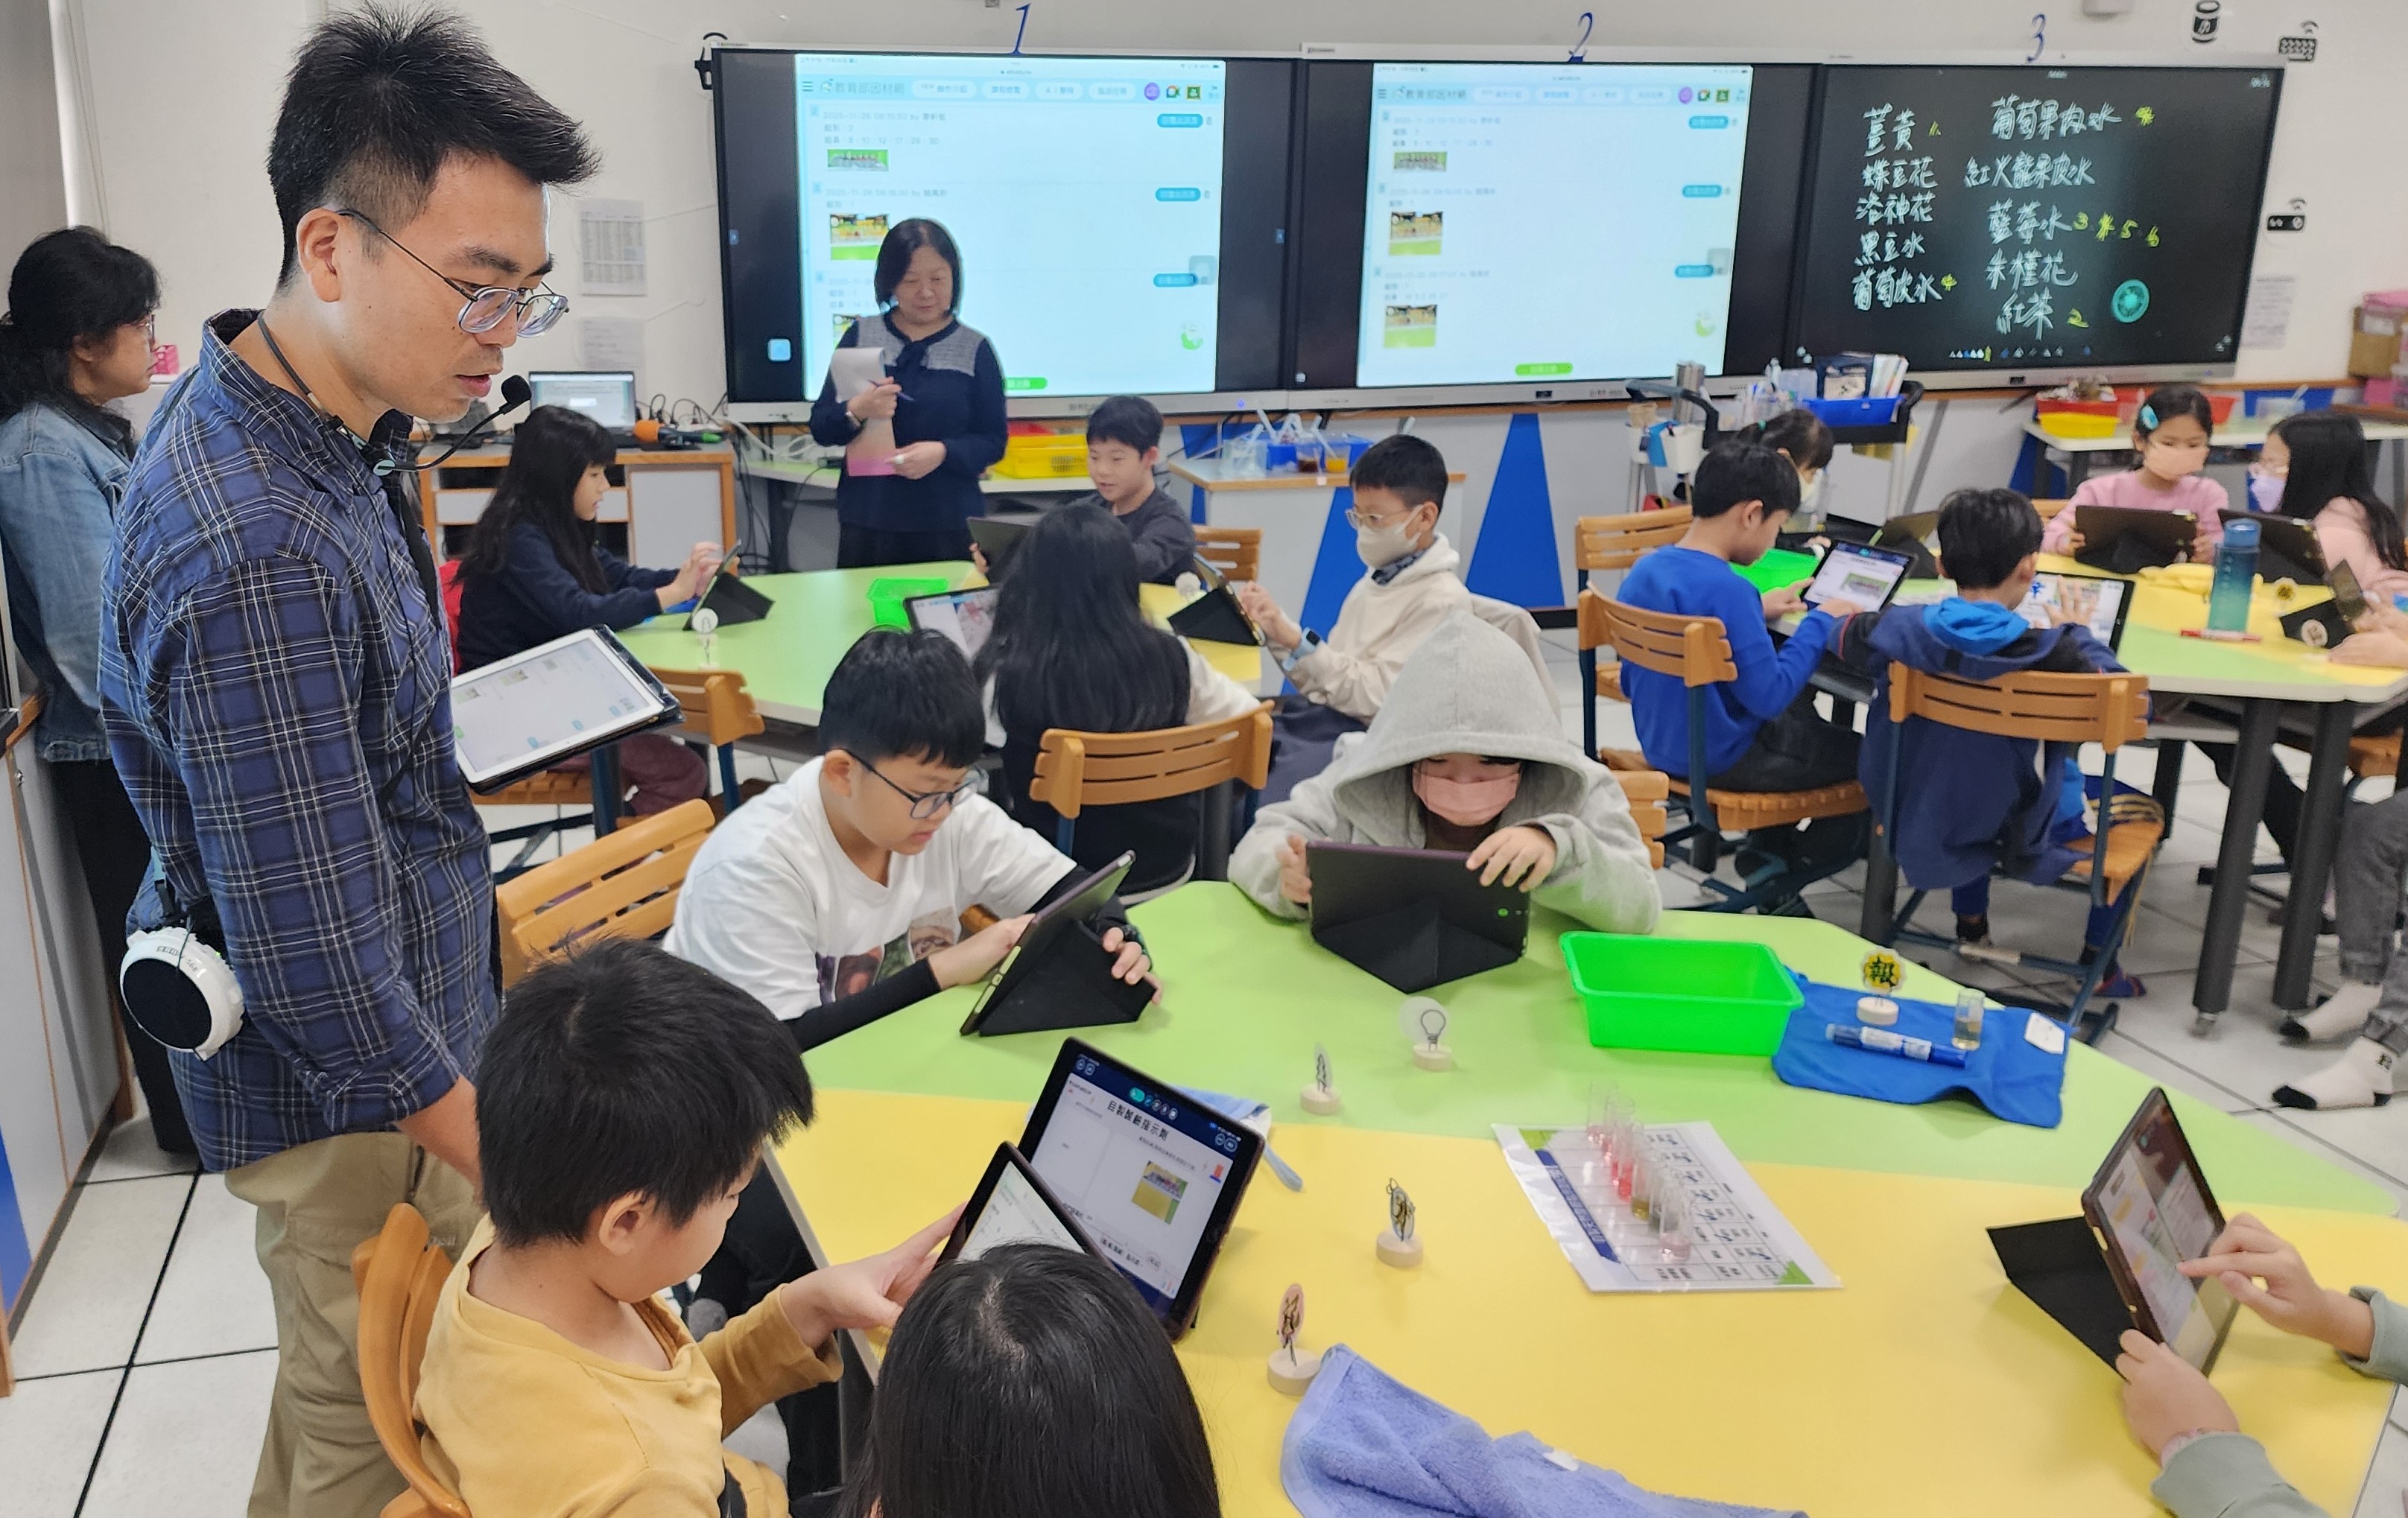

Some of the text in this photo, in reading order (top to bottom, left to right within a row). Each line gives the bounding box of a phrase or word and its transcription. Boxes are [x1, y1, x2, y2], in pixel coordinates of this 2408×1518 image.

[1012, 3, 1031, 55] 1
[1568, 11, 1593, 63] 2
[2027, 13, 2046, 63] 3
[1855, 189, 1936, 226] 洛神花
[2073, 212, 2088, 230] 3
[1854, 230, 1925, 266] 黑豆水
[2119, 218, 2138, 239] 5
[2146, 225, 2160, 247] 6
[1996, 286, 2089, 341] 紅茶 2
